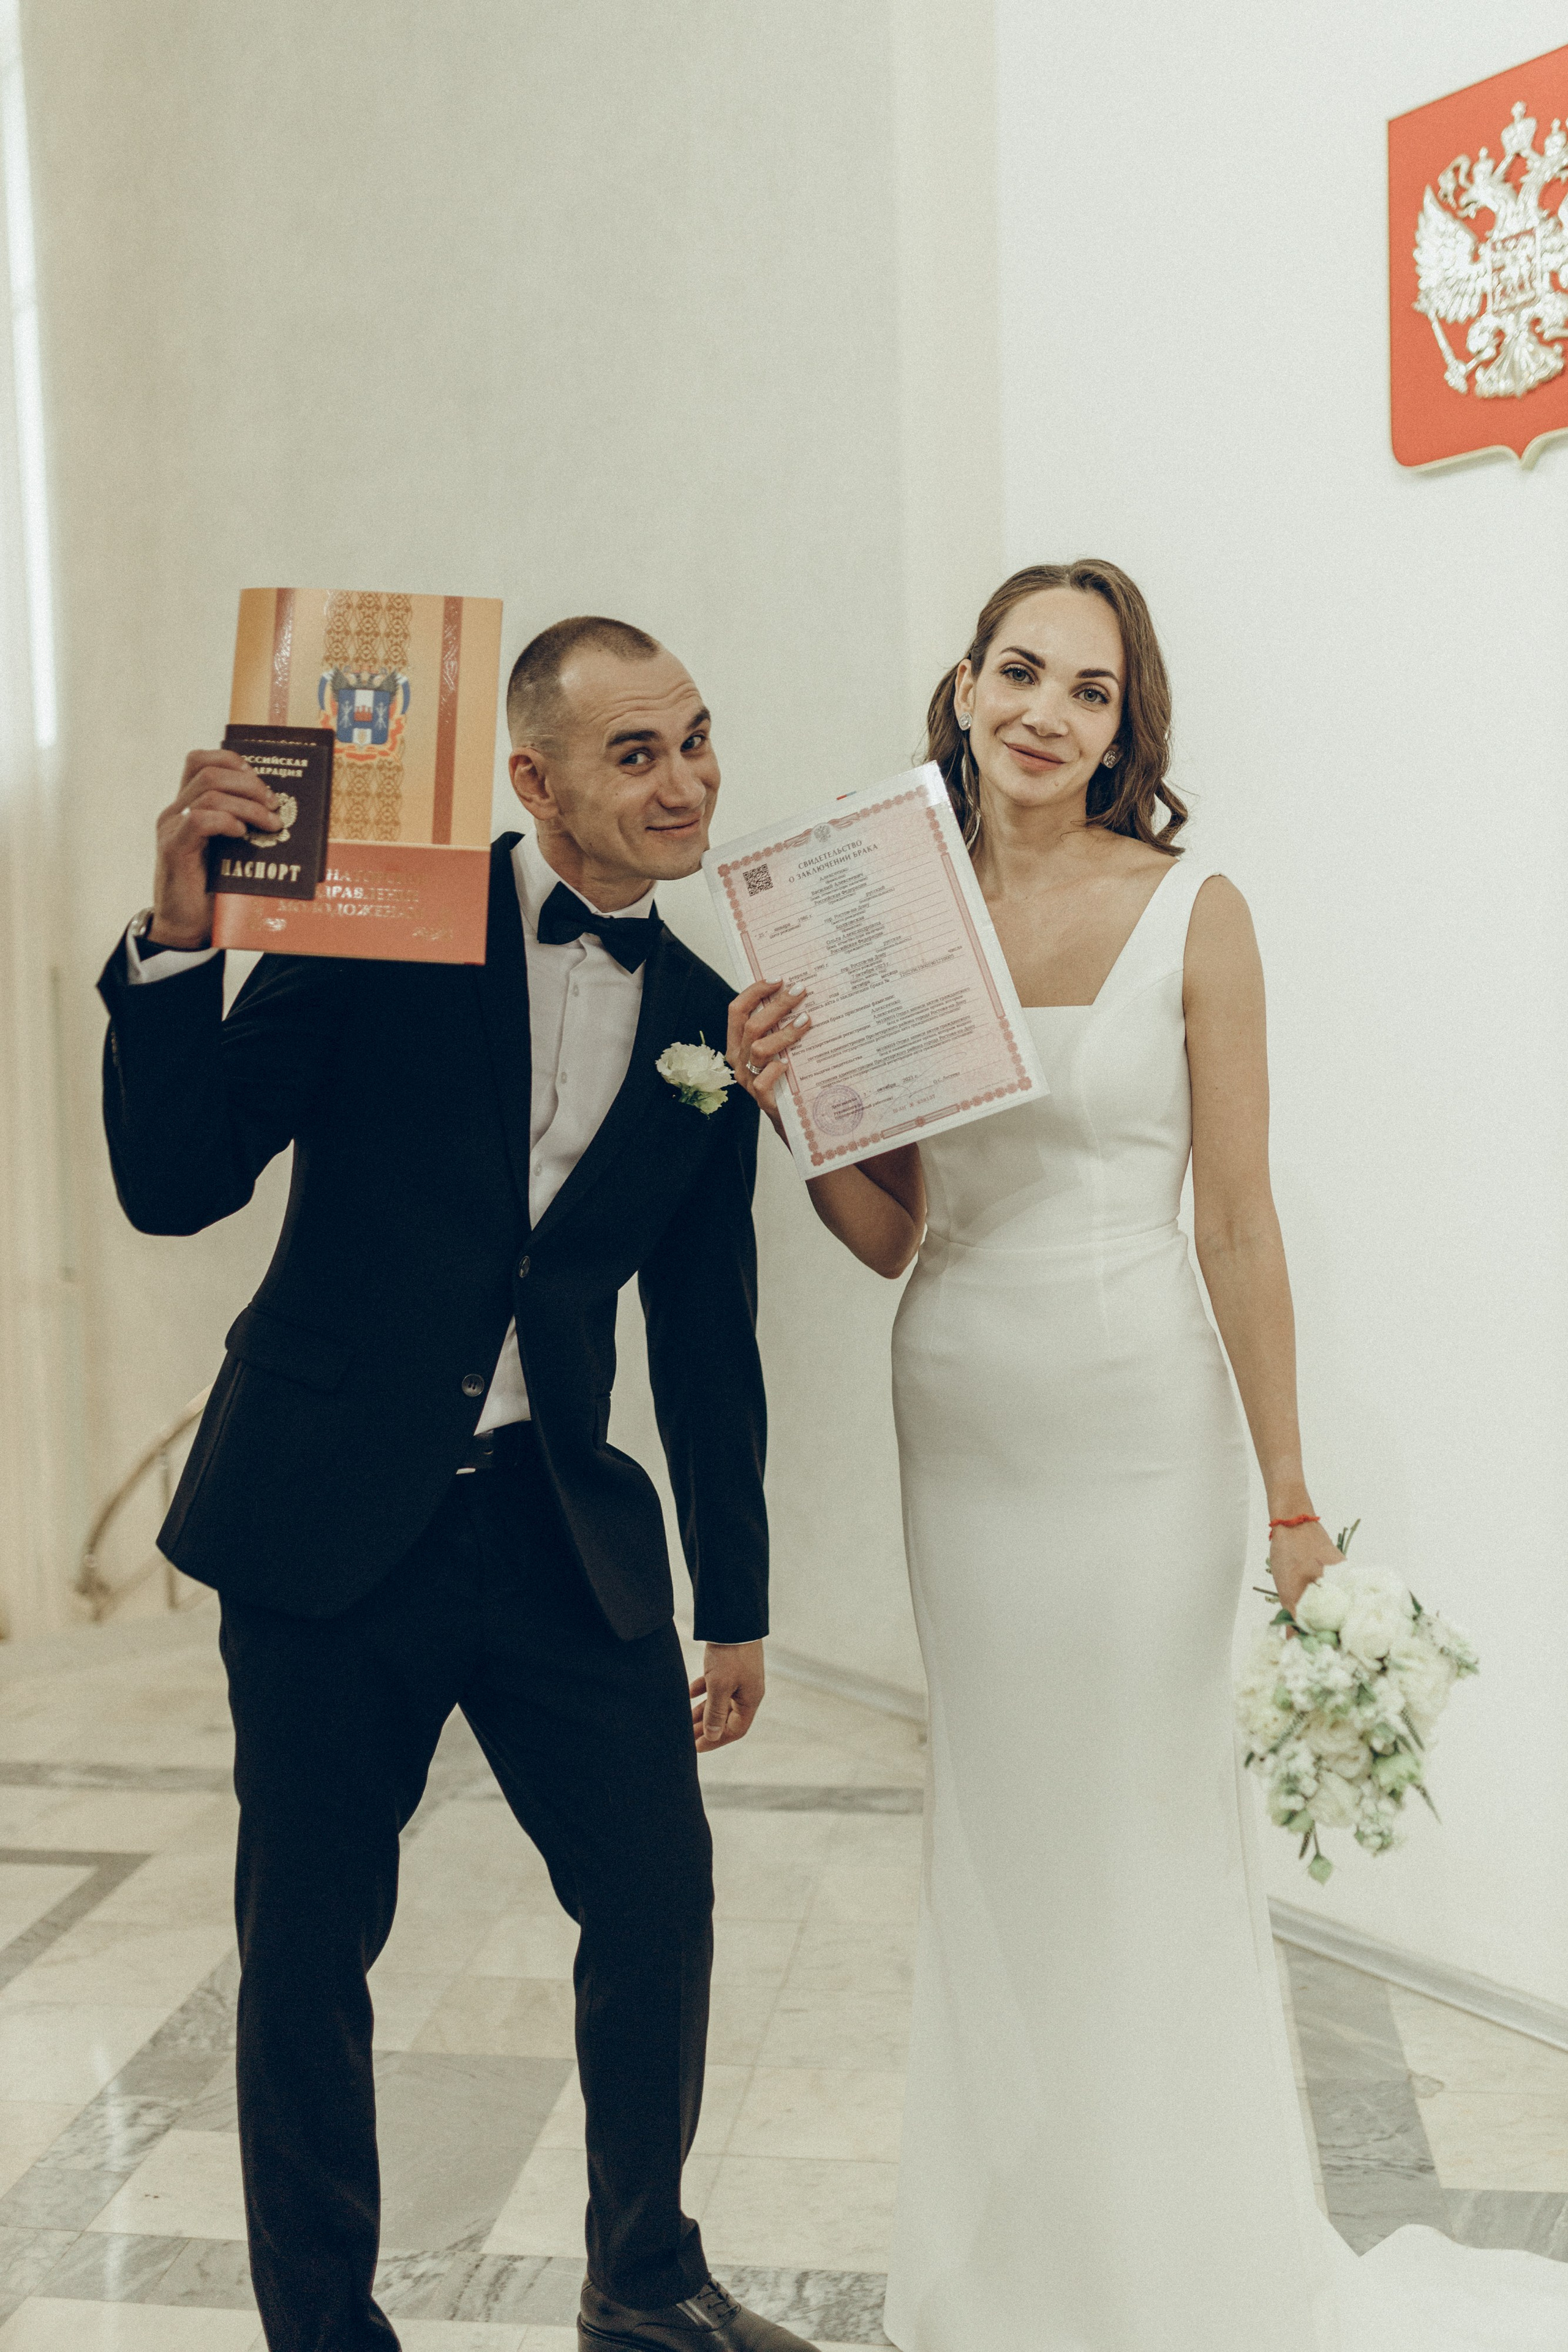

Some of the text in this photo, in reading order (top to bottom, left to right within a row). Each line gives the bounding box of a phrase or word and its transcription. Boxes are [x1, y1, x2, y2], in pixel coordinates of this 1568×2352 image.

[241, 755, 308, 767] ОССИЙСКАЯ
[253, 767, 303, 778] ДЕРАЦИЯ
[796, 854, 851, 880] ЗАКЛЮЧЕНИИ
[853, 843, 878, 858] БРАКА
[798, 839, 862, 869] СВИДЕТЕЛЬСТВО
[221, 859, 301, 882] ПАСПОРТ
